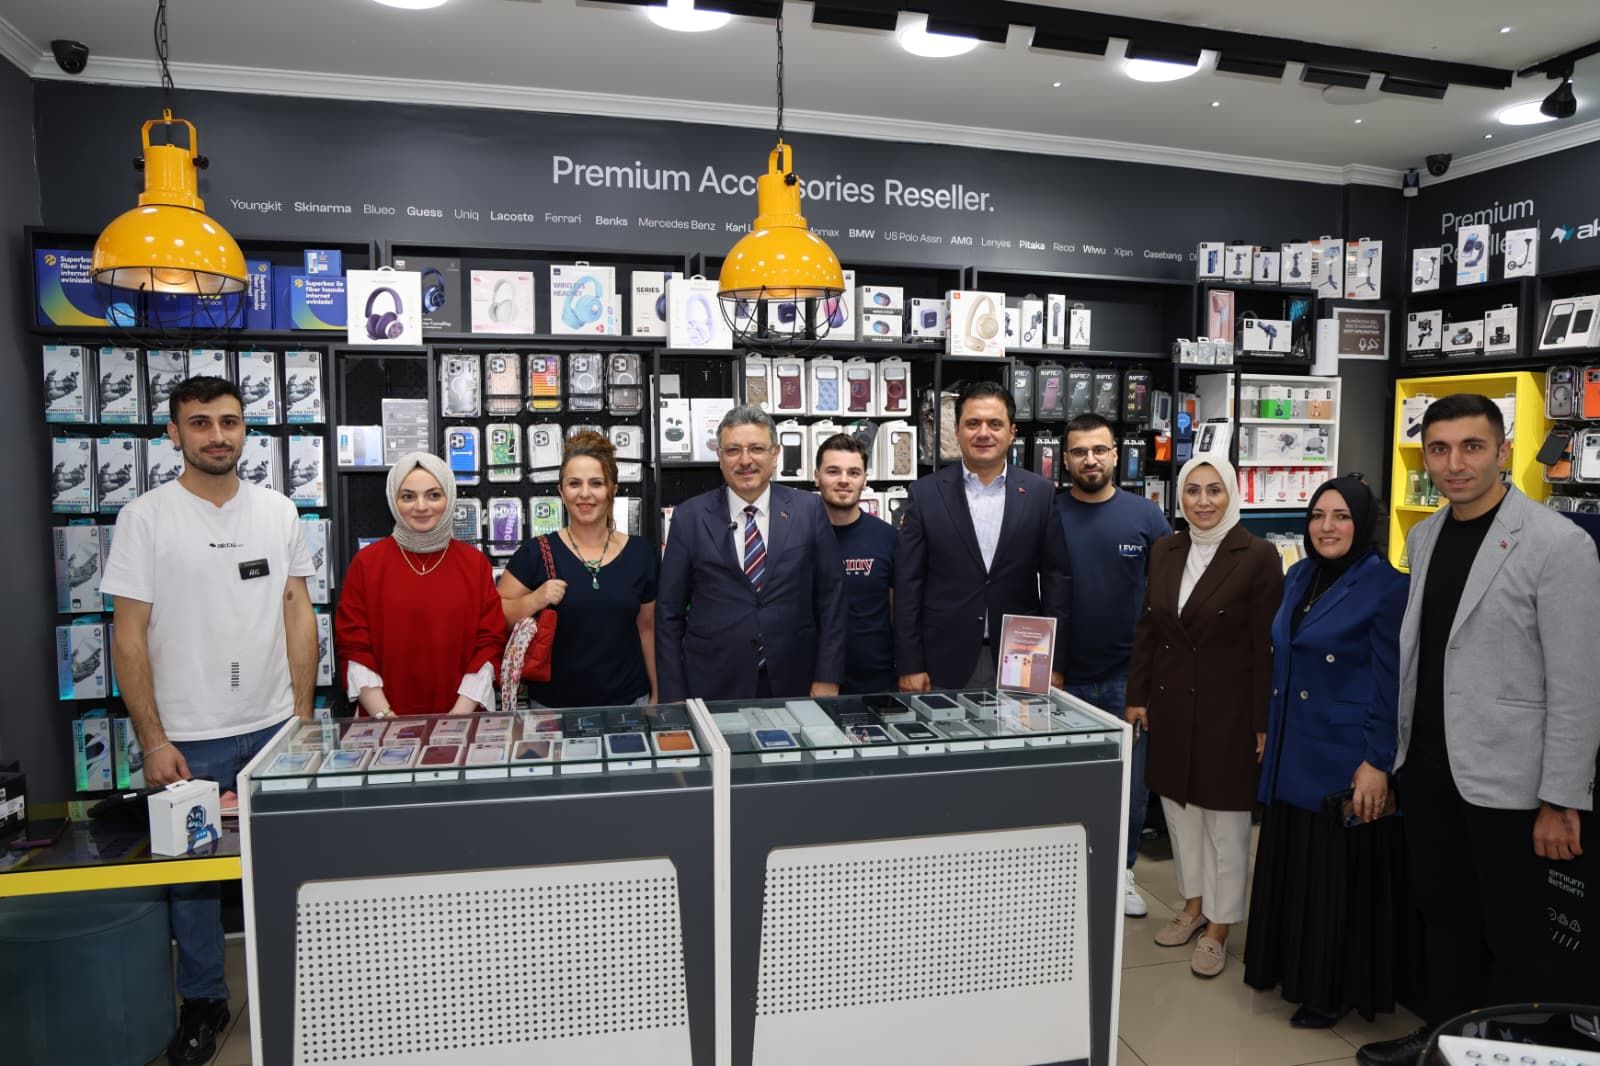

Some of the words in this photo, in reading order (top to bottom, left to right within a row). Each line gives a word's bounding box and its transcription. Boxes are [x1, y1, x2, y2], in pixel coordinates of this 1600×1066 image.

[553, 155, 690, 192] Premium
[699, 165, 875, 204] Accsories
[885, 178, 994, 212] Reseller.
[230, 198, 282, 213] Youngkit
[294, 201, 352, 213] Skinarma
[363, 203, 396, 215] Blueo
[406, 206, 443, 218] Guess
[454, 208, 479, 221] Uniq
[490, 210, 534, 222] Lacoste
[545, 212, 582, 224] Ferrari
[595, 215, 628, 226] Benks
[638, 217, 690, 229] Mercedes
[691, 219, 717, 231] Benz
[725, 222, 746, 232] Karl
[1442, 199, 1534, 235] Premium
[848, 228, 875, 239] BMW
[884, 231, 898, 241] US
[899, 231, 919, 242] Polo
[919, 233, 943, 243] Assn
[950, 236, 973, 246] AMG
[1019, 239, 1046, 250] Pitaka
[1053, 242, 1075, 252] Recci
[1083, 244, 1106, 255] Wiwu
[1143, 249, 1183, 262] Casebang
